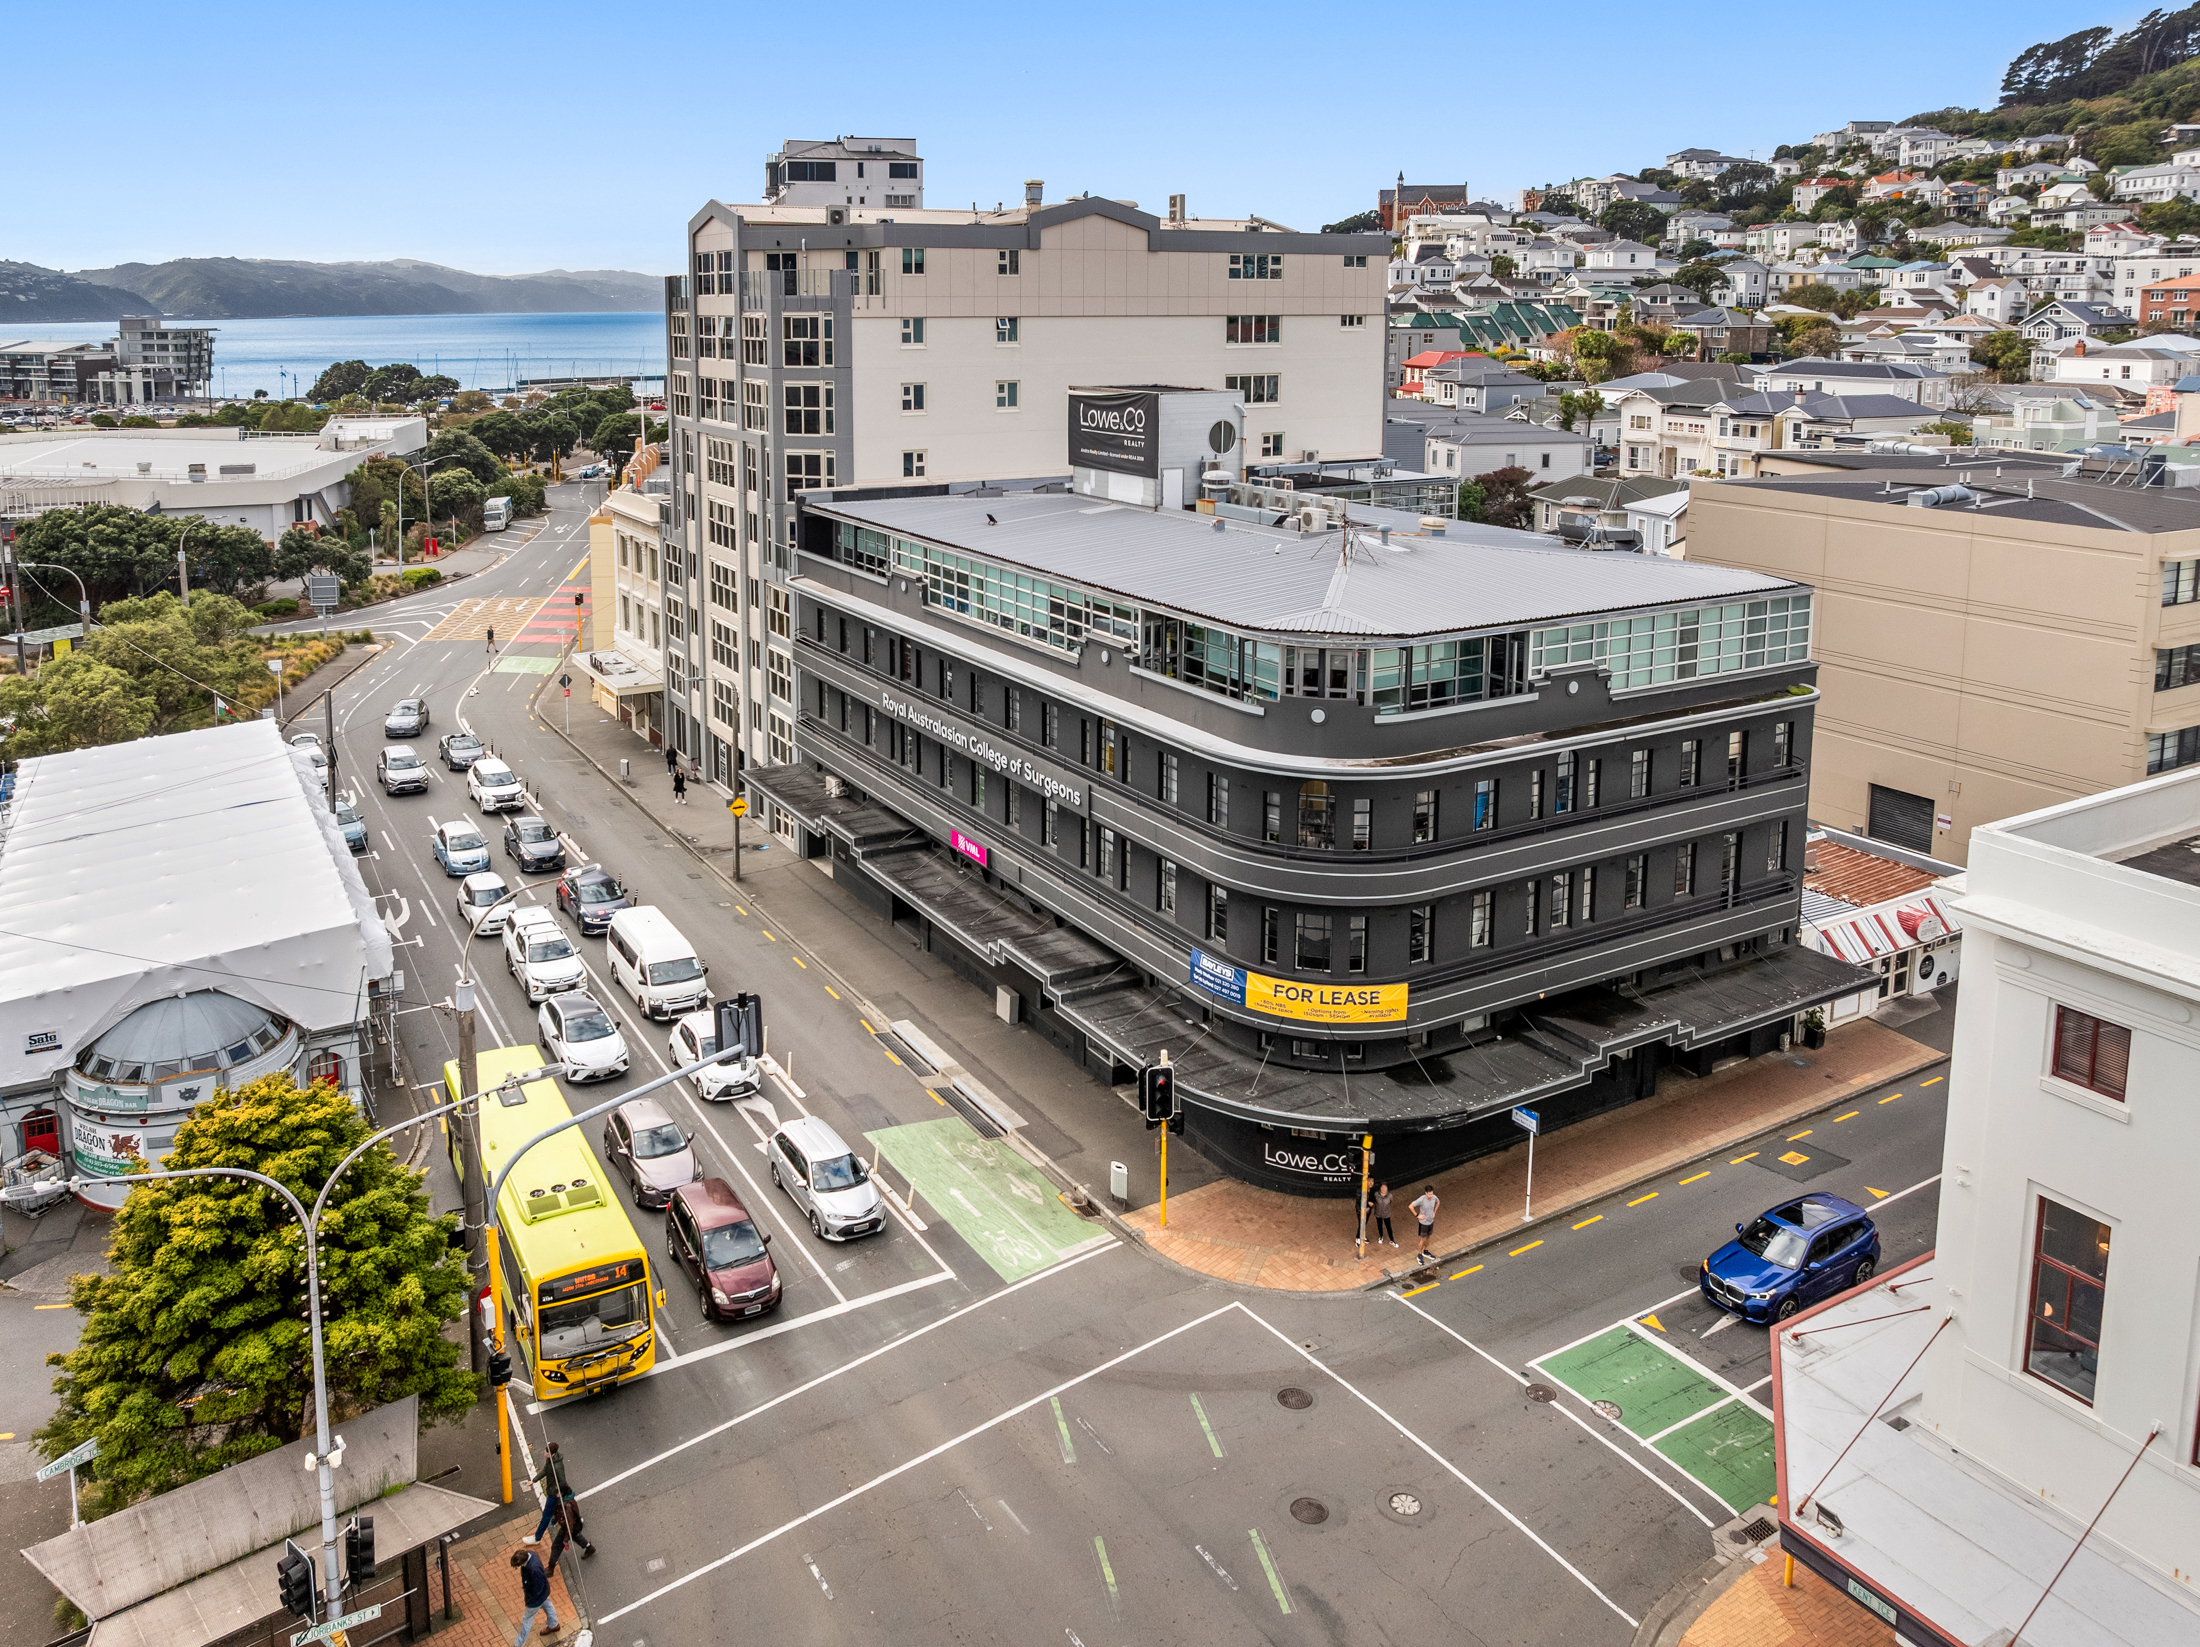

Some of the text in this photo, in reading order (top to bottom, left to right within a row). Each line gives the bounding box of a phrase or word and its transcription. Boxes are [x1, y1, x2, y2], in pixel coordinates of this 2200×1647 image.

[1124, 440, 1145, 448] REALTY
[882, 692, 1081, 806] Royal Australasian College of Surgeons
[965, 840, 980, 858] VML
[1202, 958, 1232, 978] BAYLEYS
[1274, 984, 1381, 1006] FOR LEASE
[1253, 1001, 1294, 1015] character space
[98, 1097, 124, 1108] DRAGON
[79, 1122, 97, 1135] WELSH
[74, 1127, 106, 1152] DRAGON
[614, 1264, 628, 1279] 14
[44, 1453, 84, 1477] CAMBRIDGE
[1853, 1584, 1892, 1620] KENT TCE
[357, 1612, 367, 1622] ST
